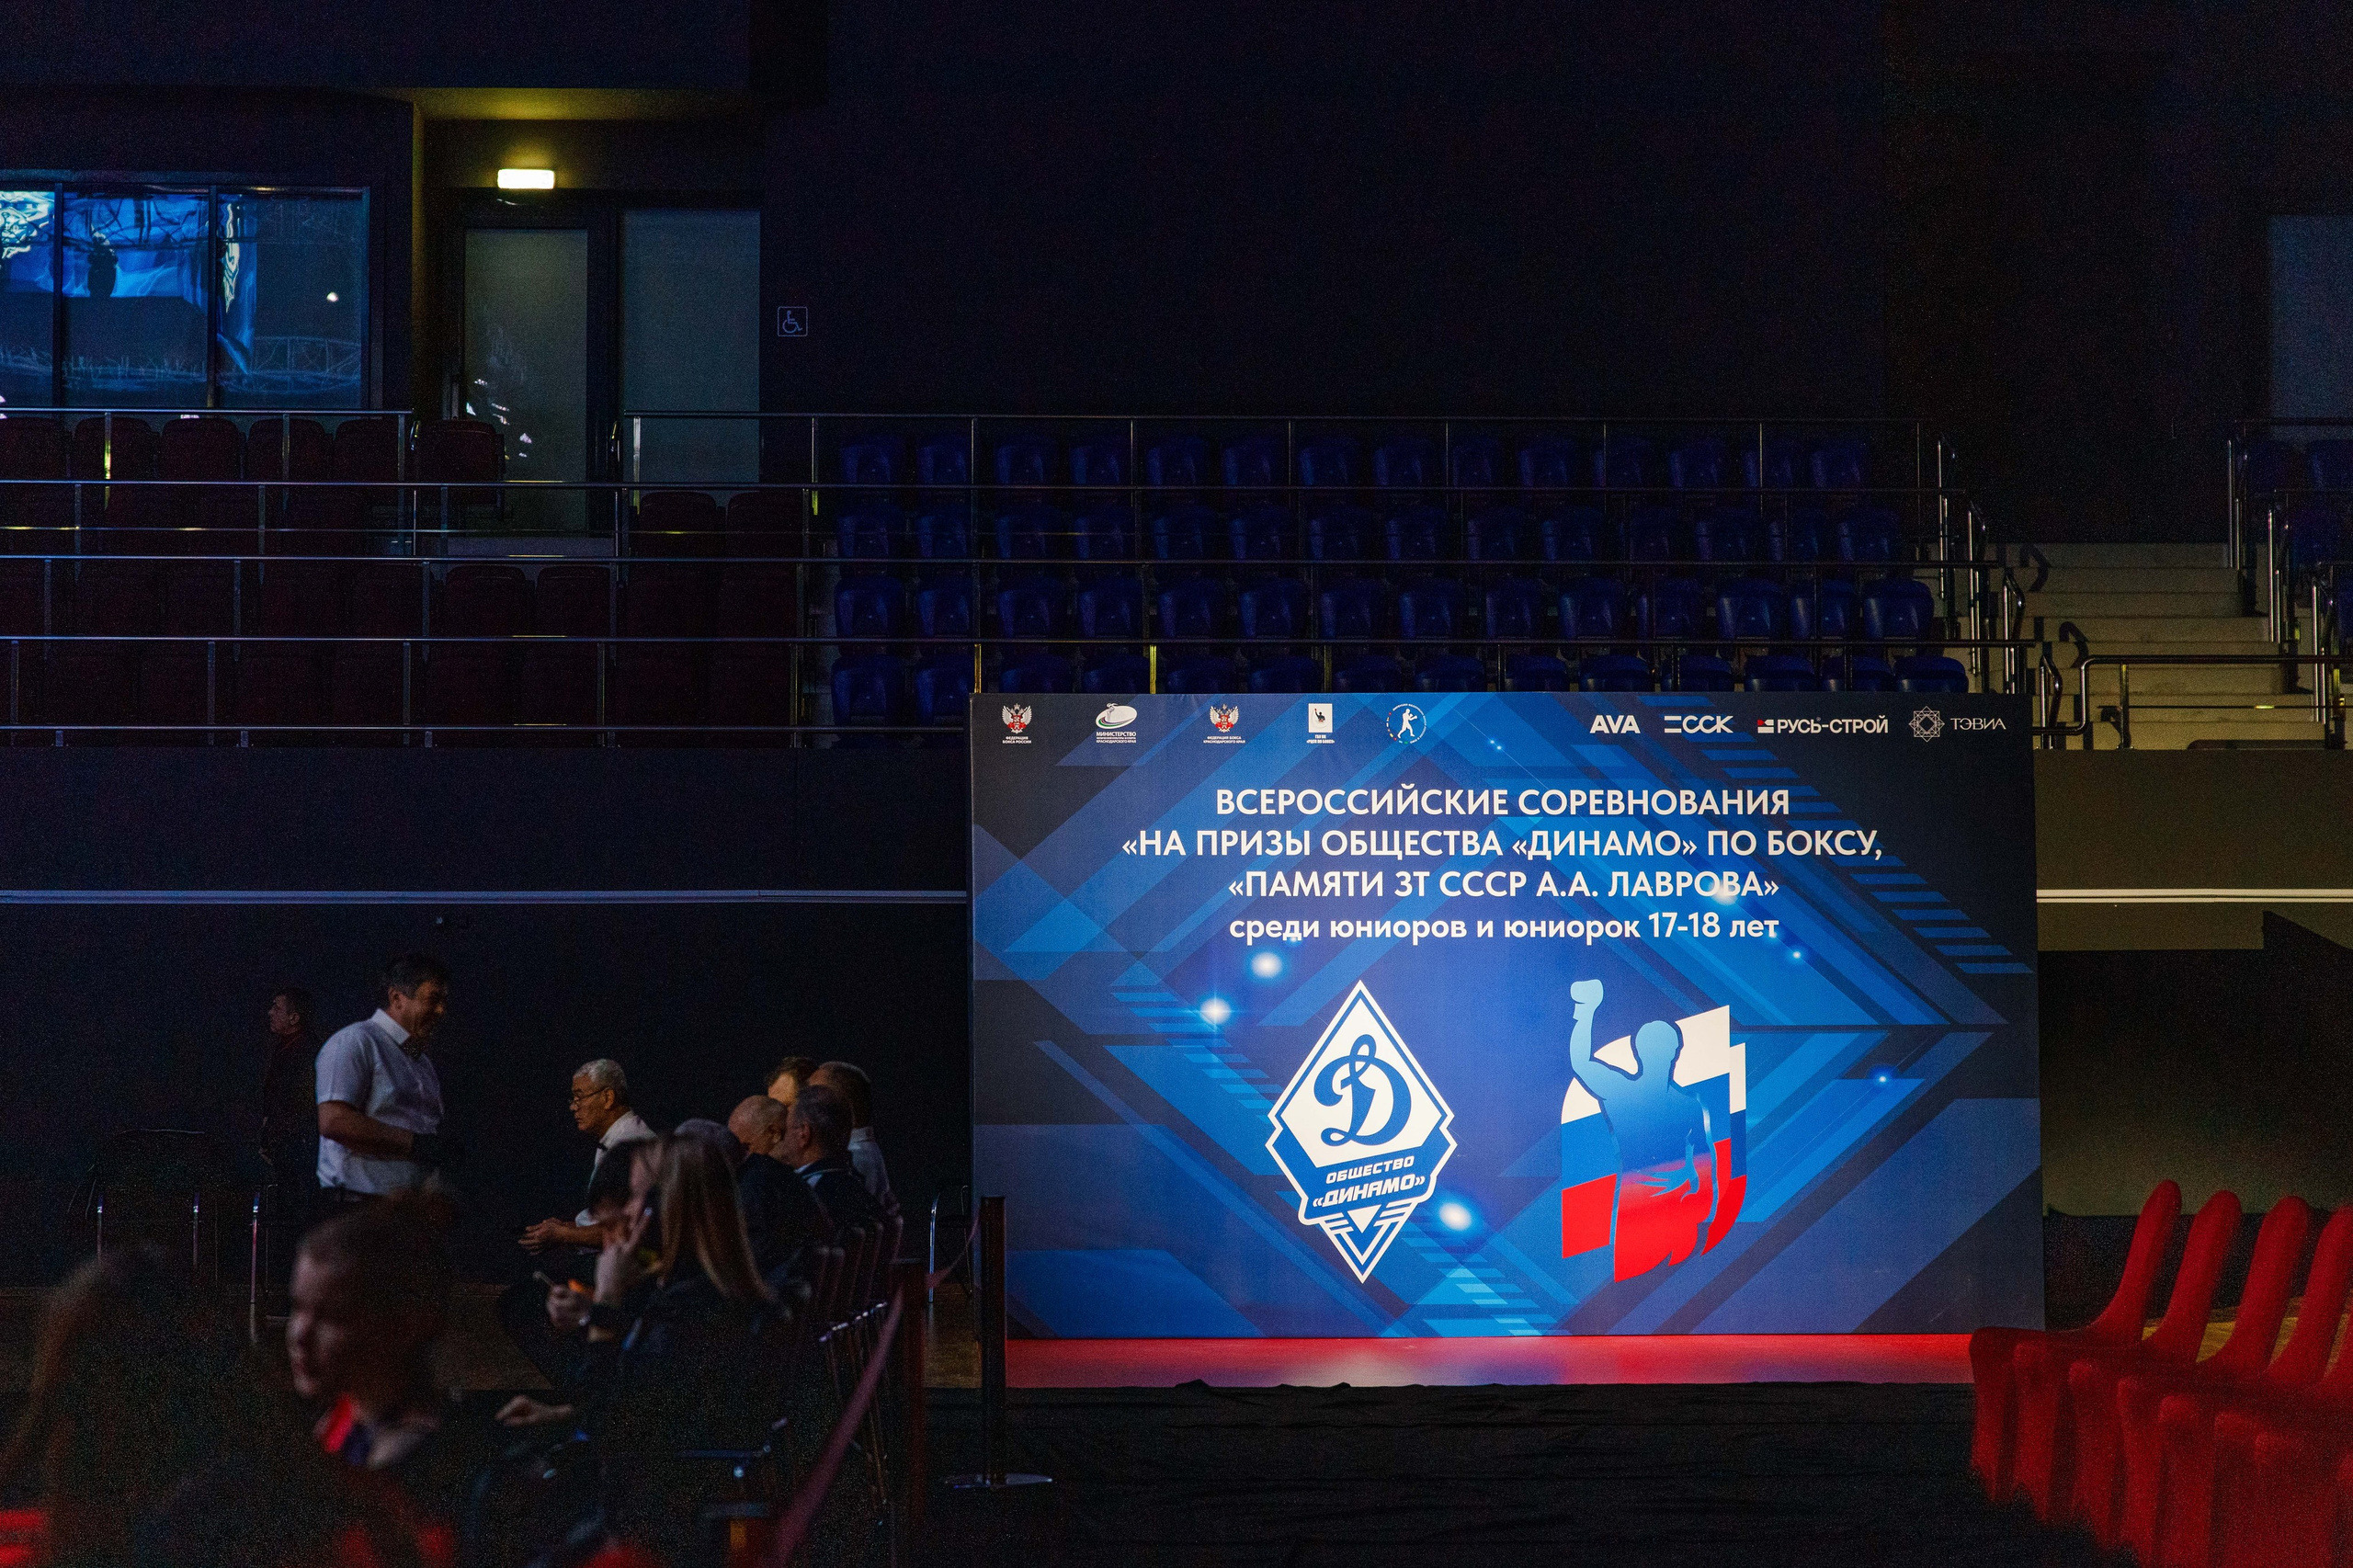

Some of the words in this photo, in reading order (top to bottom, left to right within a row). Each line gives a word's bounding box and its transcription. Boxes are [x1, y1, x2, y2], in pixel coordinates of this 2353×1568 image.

[1589, 714, 1641, 734] AVA
[1777, 714, 1889, 734] РУСЬ-СТРОЙ
[1949, 717, 2007, 731] ТЭВИА
[1216, 783, 1508, 816] ВСЕРОССИЙСКИЕ
[1518, 789, 1790, 816] СОРЕВНОВАНИЯ
[1121, 829, 1187, 857] «НА
[1197, 829, 1311, 857] ПРИЗЫ
[1321, 829, 1504, 861] ОБЩЕСТВА
[1512, 830, 1698, 861] «ДИНАМО»
[1708, 830, 1756, 857] ПО
[1768, 830, 1882, 860] БОКСУ,
[1228, 870, 1383, 898] «ПАМЯТИ
[1393, 870, 1430, 898] ЗТ
[1438, 870, 1527, 898] СССР
[1536, 870, 1598, 898] А.А.
[1608, 870, 1779, 898] ЛАВРОВА»
[1229, 919, 1320, 947] среди
[1330, 919, 1468, 946] юниоров
[1476, 919, 1494, 938] и
[1504, 919, 1642, 946] юниорок
[1648, 911, 1721, 938] 17-18
[1729, 919, 1779, 938] лет
[1325, 1155, 1415, 1184] ОБЩЕСТВО
[1313, 1174, 1426, 1208] «ДИНАМО»
